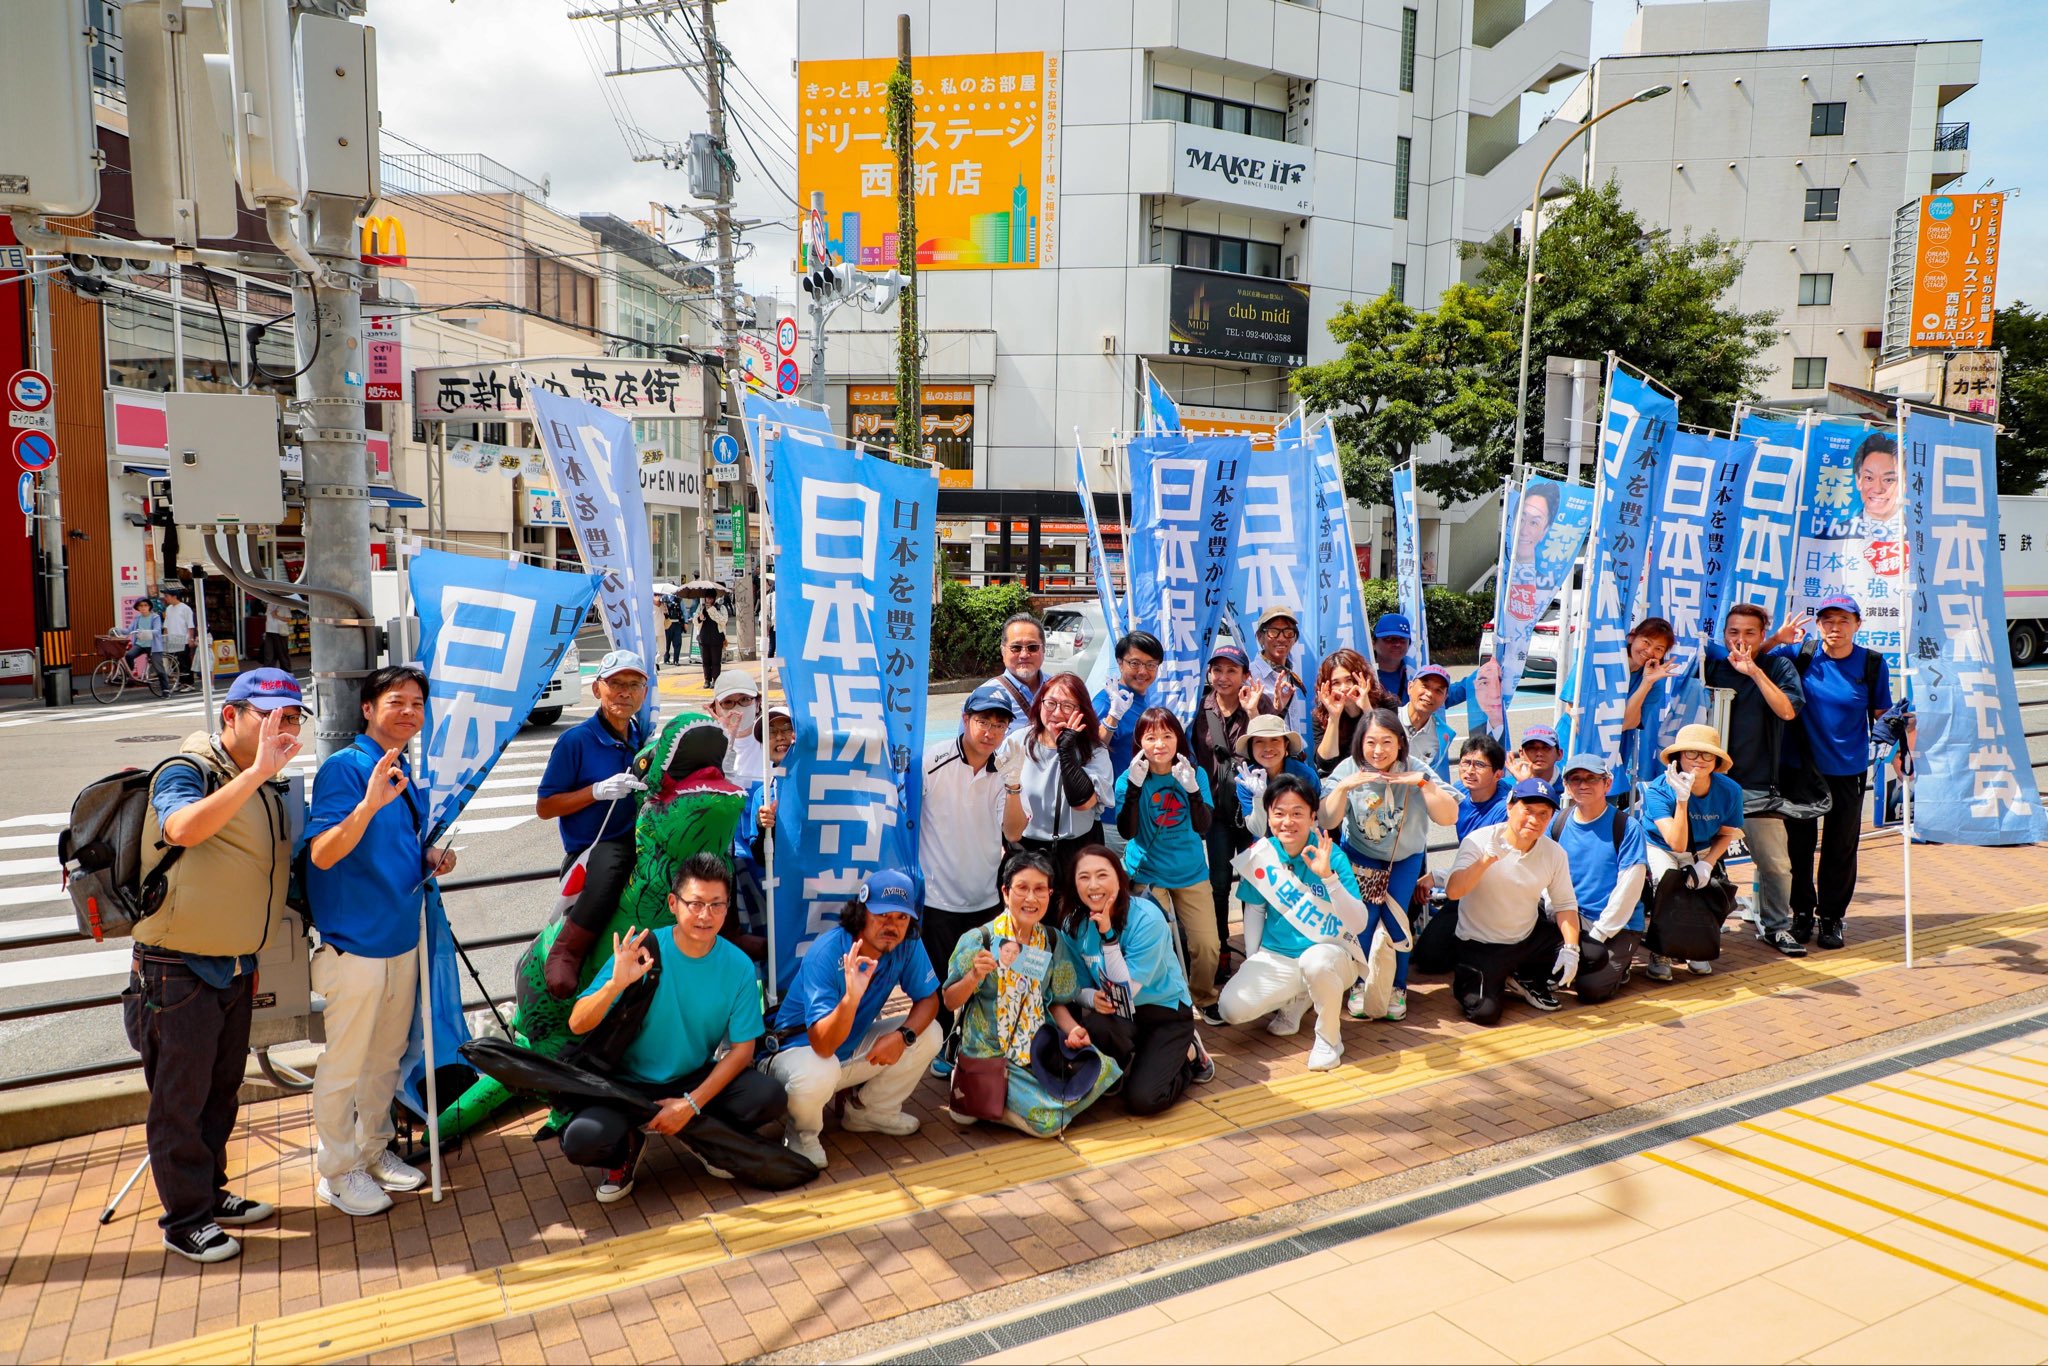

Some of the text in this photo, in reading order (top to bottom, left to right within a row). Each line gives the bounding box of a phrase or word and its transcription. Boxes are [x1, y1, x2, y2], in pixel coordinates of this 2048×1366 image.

[806, 75, 1036, 99] きっと見つる、私のお部屋
[1186, 148, 1265, 184] MAKE
[1264, 182, 1284, 191] STUDIO
[1297, 200, 1308, 209] 4F
[1960, 199, 1985, 331] ドリームステージ
[1979, 198, 1999, 323] きっと見つかる、私のお部屋
[1228, 302, 1291, 324] club midi
[1943, 292, 1960, 331] 西新店
[781, 327, 793, 346] 50
[1187, 320, 1210, 331] MIDI
[1245, 330, 1292, 343] 092-400-3588
[1916, 331, 1986, 341] 商店街入口スグ
[367, 386, 400, 398] 処方せん
[1822, 453, 1852, 467] もり
[640, 467, 675, 493] OPEN
[1814, 464, 1854, 509] 森
[1811, 515, 1907, 538] けんたろう
[1203, 459, 1239, 648] 日本を豊かに
[1804, 550, 1860, 573] 日本を
[1865, 607, 1901, 618] 演説会
[885, 498, 920, 832] 日本を豊かに、強く。
[1536, 780, 1549, 795] LA
[881, 886, 909, 900] AVIREX
